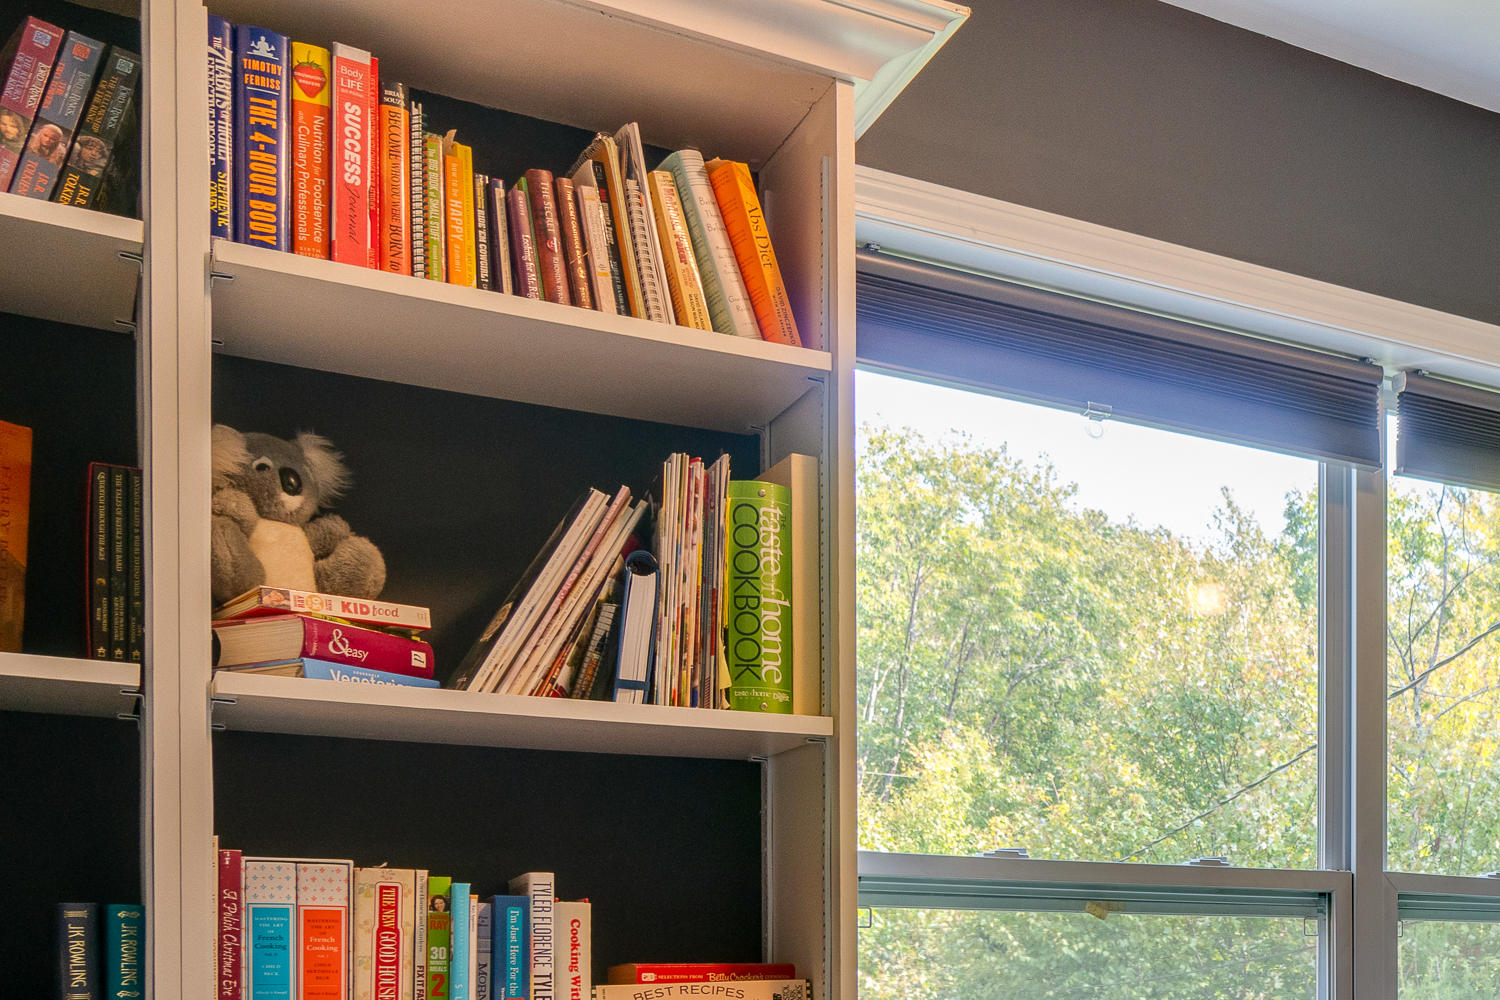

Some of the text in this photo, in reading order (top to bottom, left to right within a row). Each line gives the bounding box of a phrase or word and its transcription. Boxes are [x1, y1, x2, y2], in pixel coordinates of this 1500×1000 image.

[242, 58, 282, 76] TIMOTHY
[244, 73, 281, 91] FERRISS
[340, 65, 364, 80] Body
[340, 78, 364, 92] LIFE
[343, 101, 362, 187] SUCCESS
[249, 97, 278, 246] THE 4-HOUR BODY
[295, 126, 310, 242] Culinary Professionals
[313, 115, 326, 243] Nutrition Foodservice
[388, 110, 403, 260] BECOME WHO YOU WERE BORN
[345, 184, 361, 245] Journal
[429, 199, 440, 243] SMALL STUFF
[541, 181, 556, 233] THE SECRET
[746, 201, 773, 269] Abs Diet
[479, 243, 488, 282] COWGIRL!
[732, 502, 762, 683] COOKBOOK
[341, 600, 370, 616] KID
[346, 647, 369, 662] easy
[381, 887, 396, 906] THE
[532, 881, 552, 910] TYLER
[223, 902, 239, 932] Polish
[381, 907, 396, 928] NEW
[430, 919, 448, 931] RAY
[68, 923, 88, 988] JK ROWLING
[120, 923, 139, 986] JK ROWLING
[254, 942, 288, 951] Cooking
[306, 944, 339, 952] Cooking
[380, 930, 398, 967] GOOD
[430, 946, 447, 960] 30
[532, 913, 552, 968] FLORENCE
[568, 918, 581, 972] Cooking
[416, 965, 425, 981] FIX
[509, 925, 520, 996] Just Here For the
[431, 974, 446, 997] 2
[706, 971, 729, 981] Betty
[679, 984, 746, 999] RECIPES
